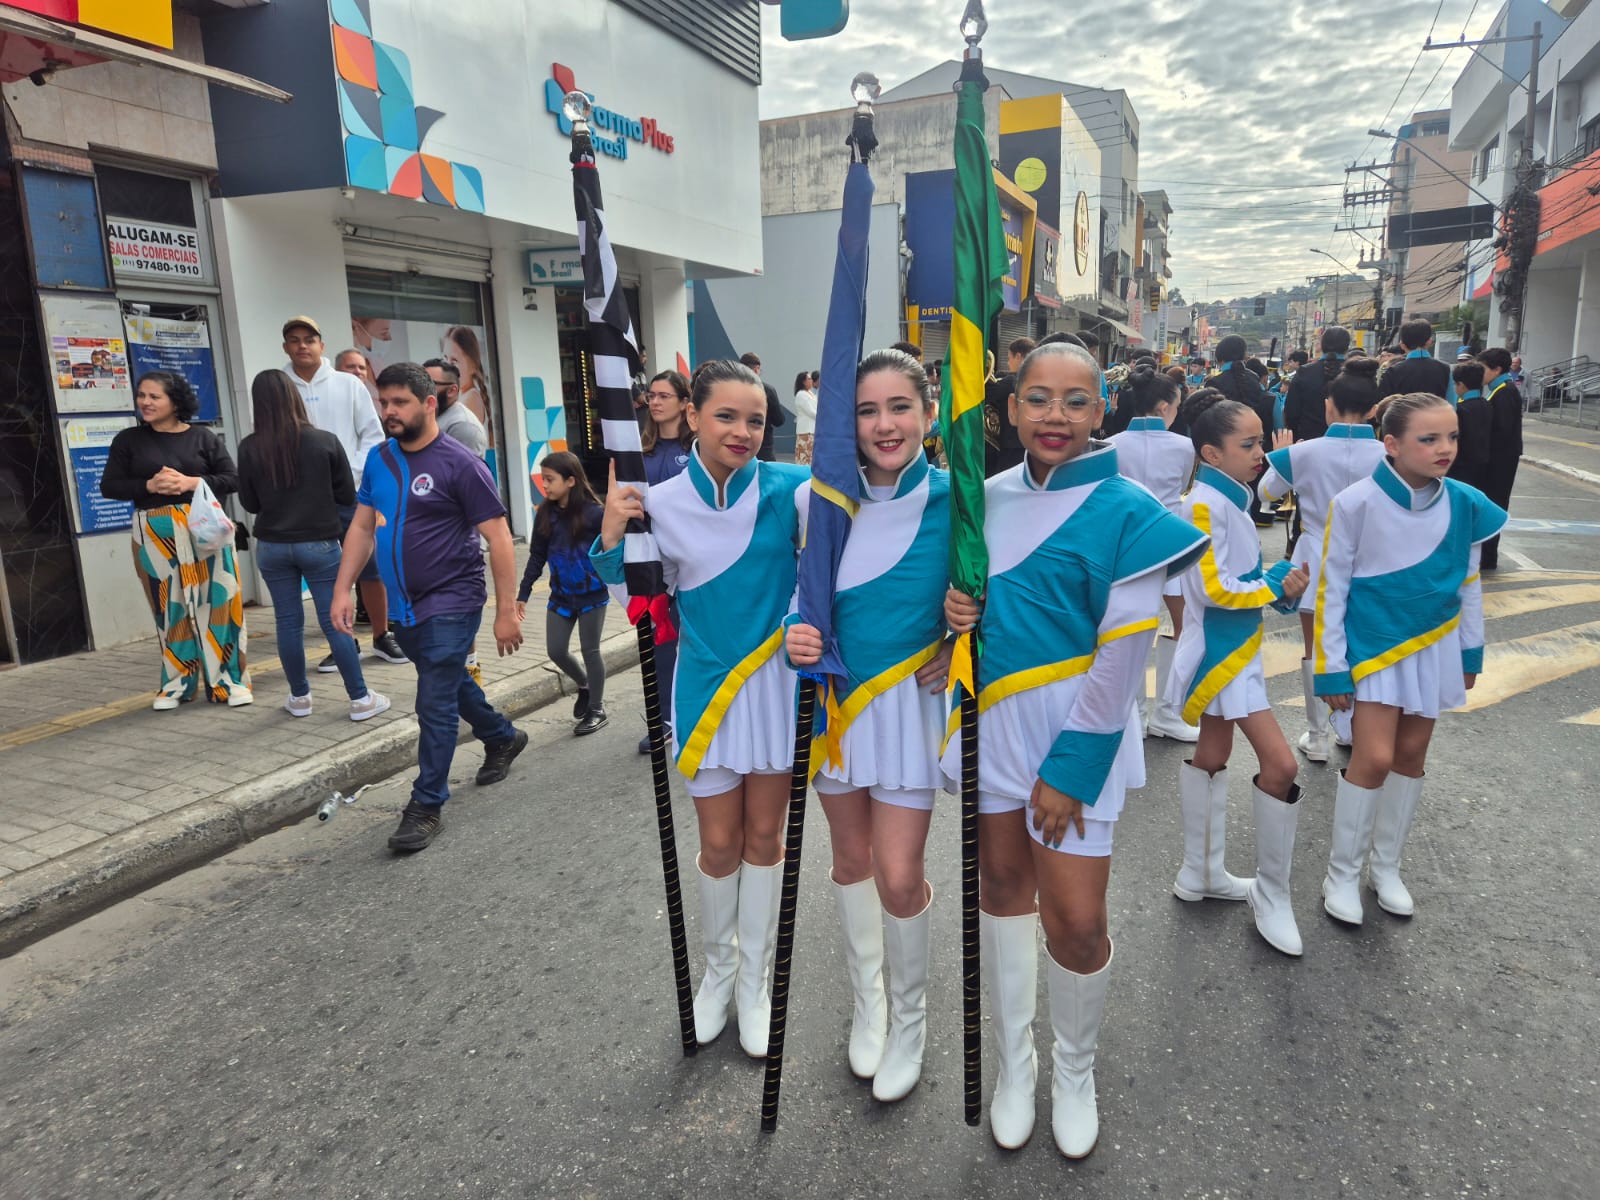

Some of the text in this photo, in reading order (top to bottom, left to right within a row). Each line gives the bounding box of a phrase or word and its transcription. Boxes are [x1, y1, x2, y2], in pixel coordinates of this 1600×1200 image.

[589, 126, 628, 161] Brasil
[107, 224, 197, 249] ALUGAM-SE
[109, 240, 198, 265] SALAS COMERCIAIS
[136, 259, 200, 276] 97480-1910
